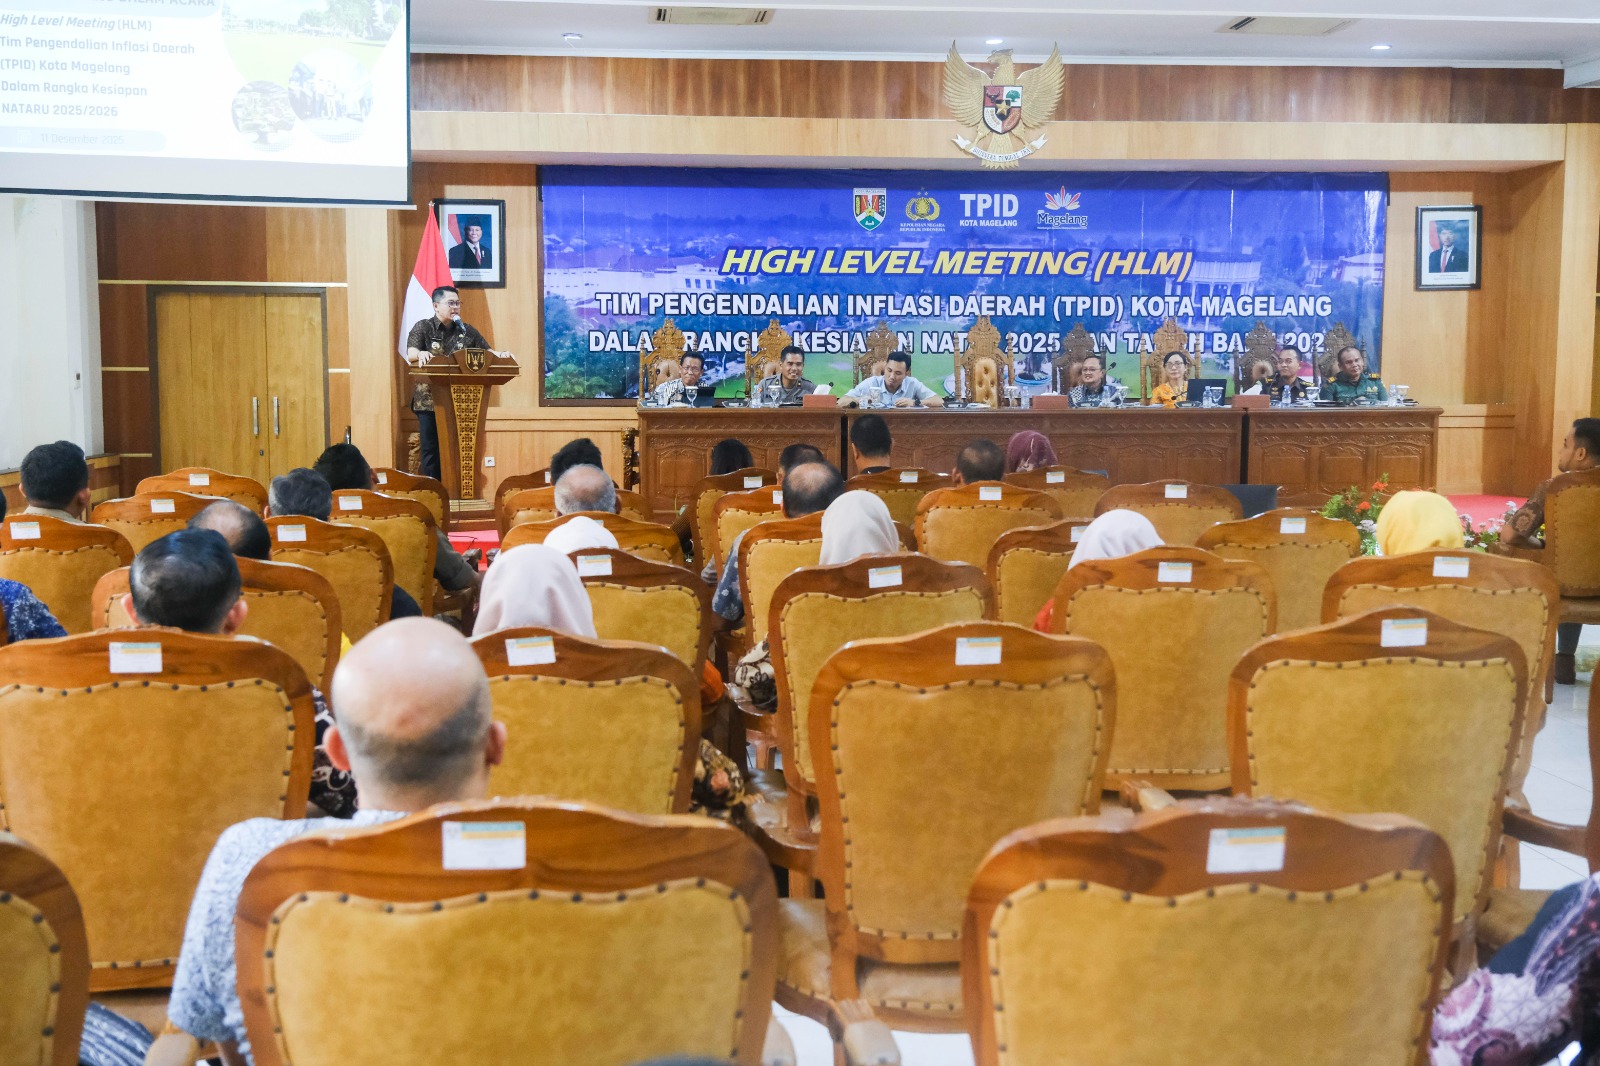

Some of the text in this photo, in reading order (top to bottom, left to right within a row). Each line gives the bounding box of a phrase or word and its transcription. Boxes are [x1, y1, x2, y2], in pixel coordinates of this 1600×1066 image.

[0, 14, 153, 31] High Level Meeting (HLM)
[0, 36, 195, 54] Tim Pengendalian Inflasi Daerah
[0, 58, 131, 75] (TPID) Kota Magelang
[1, 80, 148, 98] Dalam Rangka Kesiapan
[1, 103, 119, 117] NATARU 2025/2026
[40, 133, 125, 145] 11 Desember 2025
[960, 193, 1019, 217] TPID
[960, 219, 1018, 227] KOTA MAGELANG
[1036, 212, 1088, 228] Magelang
[721, 249, 1193, 282] HIGH LEVEL MEETING (HLM)
[595, 293, 1332, 322] TIM PENGENDALIAN INFLASI DAERAH (TPID) KOTA MAGELANG
[588, 331, 657, 353] DALA
[793, 332, 914, 353] KESIAN
[1004, 332, 1061, 353] 2025
[1123, 333, 1205, 353] TAN
[1284, 332, 1328, 353] 202
